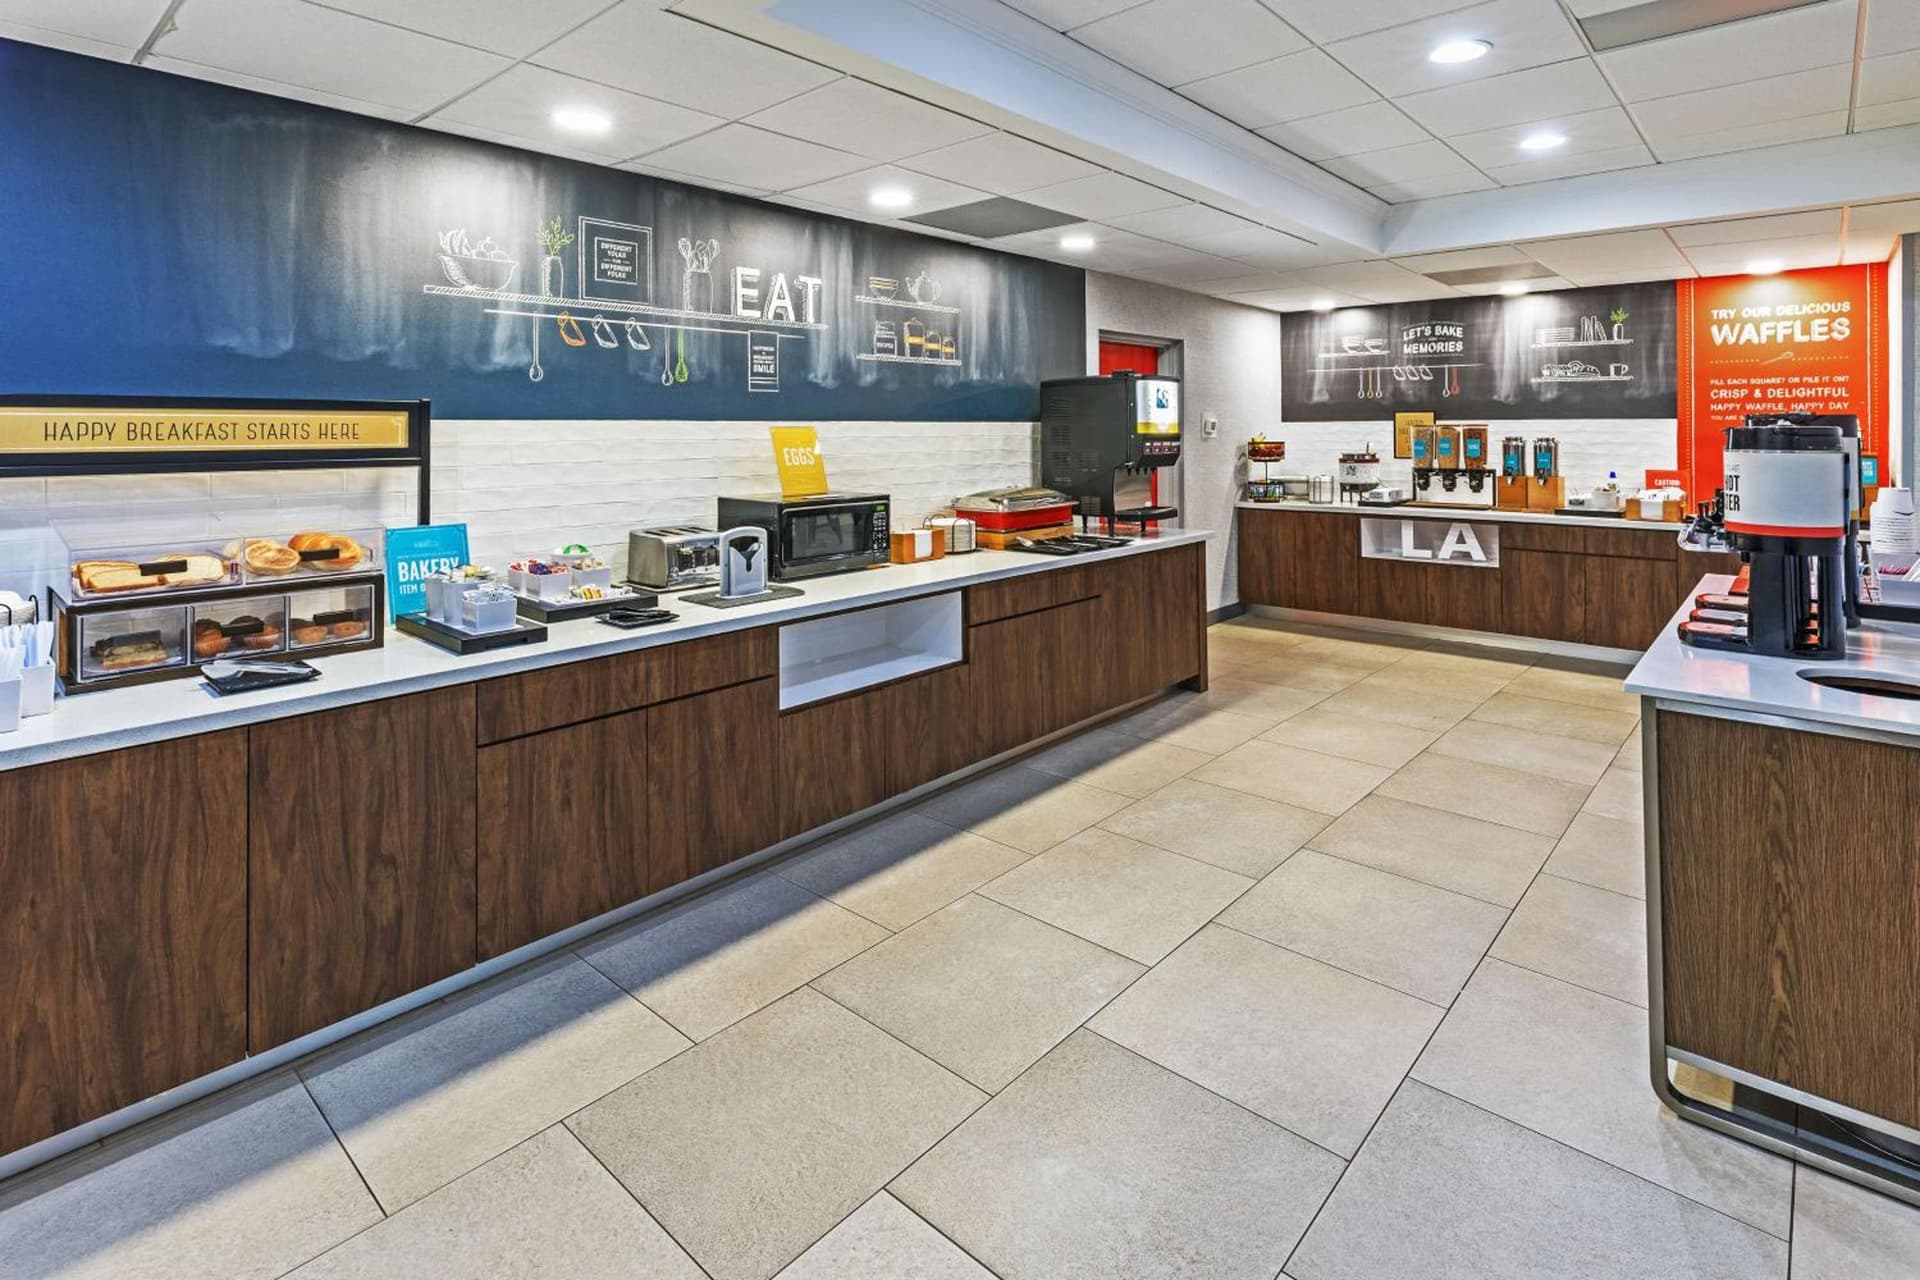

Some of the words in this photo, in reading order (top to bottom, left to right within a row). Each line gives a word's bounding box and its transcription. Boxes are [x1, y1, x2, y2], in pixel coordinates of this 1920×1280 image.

[730, 266, 822, 324] EAT
[1711, 309, 1736, 320] TRY
[1741, 306, 1771, 319] OUR
[1775, 301, 1850, 316] DELICIOUS
[1403, 326, 1431, 341] LET'S
[1434, 324, 1463, 338] BAKE
[1710, 317, 1851, 346] WAFFLES
[1403, 340, 1463, 354] MEMORIES
[753, 364, 775, 373] SMILE
[1710, 388, 1748, 400] CRISP
[1754, 388, 1762, 399] &
[1767, 386, 1849, 399] DELIGHTFUL
[1710, 403, 1741, 412] HAPPY
[1791, 402, 1825, 411] HAPPY
[1829, 401, 1849, 410] DAY
[44, 421, 116, 441] HAPPY
[127, 421, 238, 441] BREAKFAST
[247, 422, 311, 440] STARTS
[319, 422, 359, 440] HERE
[783, 447, 815, 466] EGGS
[1401, 519, 1487, 561] LA
[398, 556, 460, 583] BAKERY
[400, 584, 418, 595] ITEM
